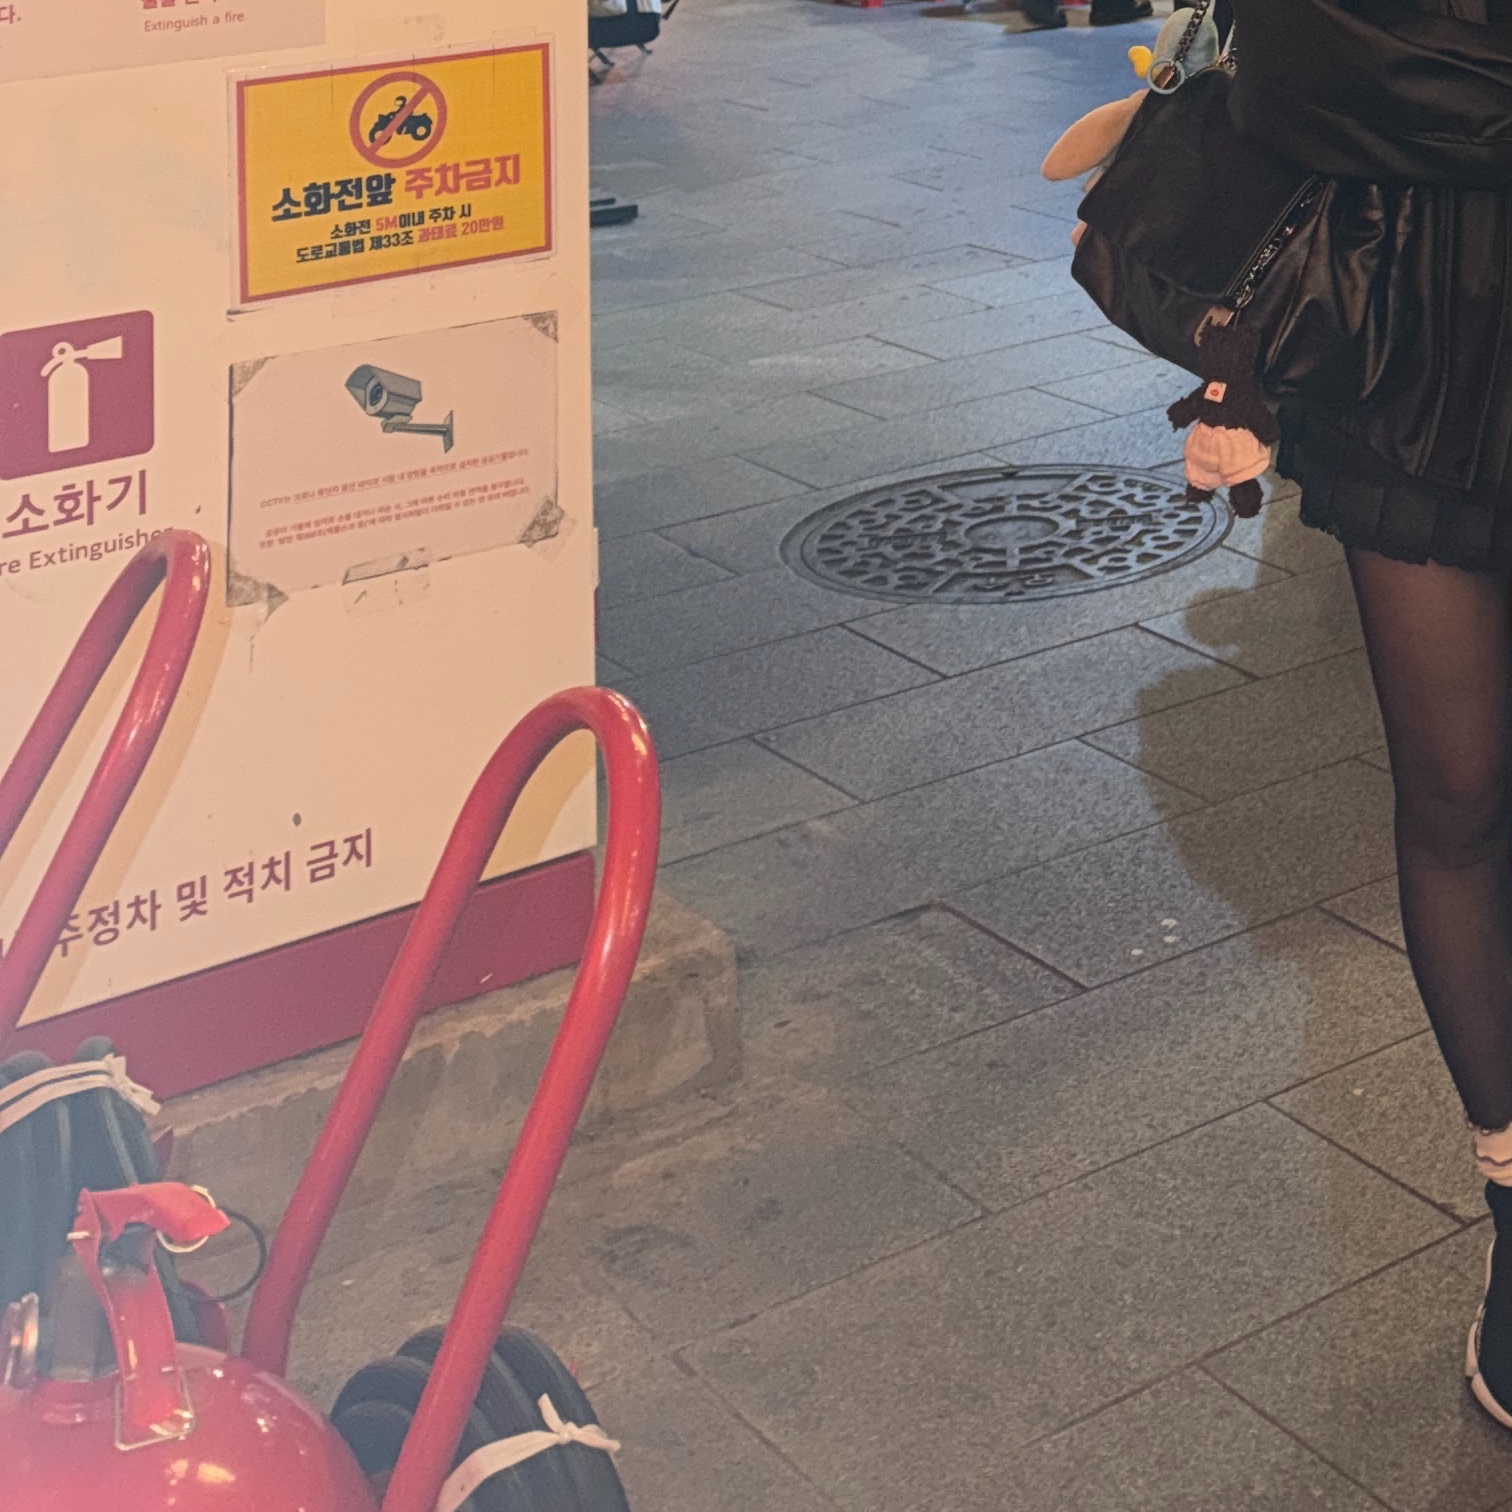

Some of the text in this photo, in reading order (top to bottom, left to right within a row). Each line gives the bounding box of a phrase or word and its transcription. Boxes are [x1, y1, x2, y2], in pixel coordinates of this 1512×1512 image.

[144, 14, 208, 32] Extinguish
[213, 15, 220, 25] a
[271, 153, 521, 223] 소화전앞 주차금지
[330, 219, 371, 240] 소화전
[429, 205, 456, 223] 주차
[459, 203, 472, 218] 시
[369, 230, 414, 252] 제33조
[2, 469, 147, 538] 소화기
[176, 875, 209, 922] 및
[223, 850, 292, 904] 적치
[306, 827, 373, 883] 금지
